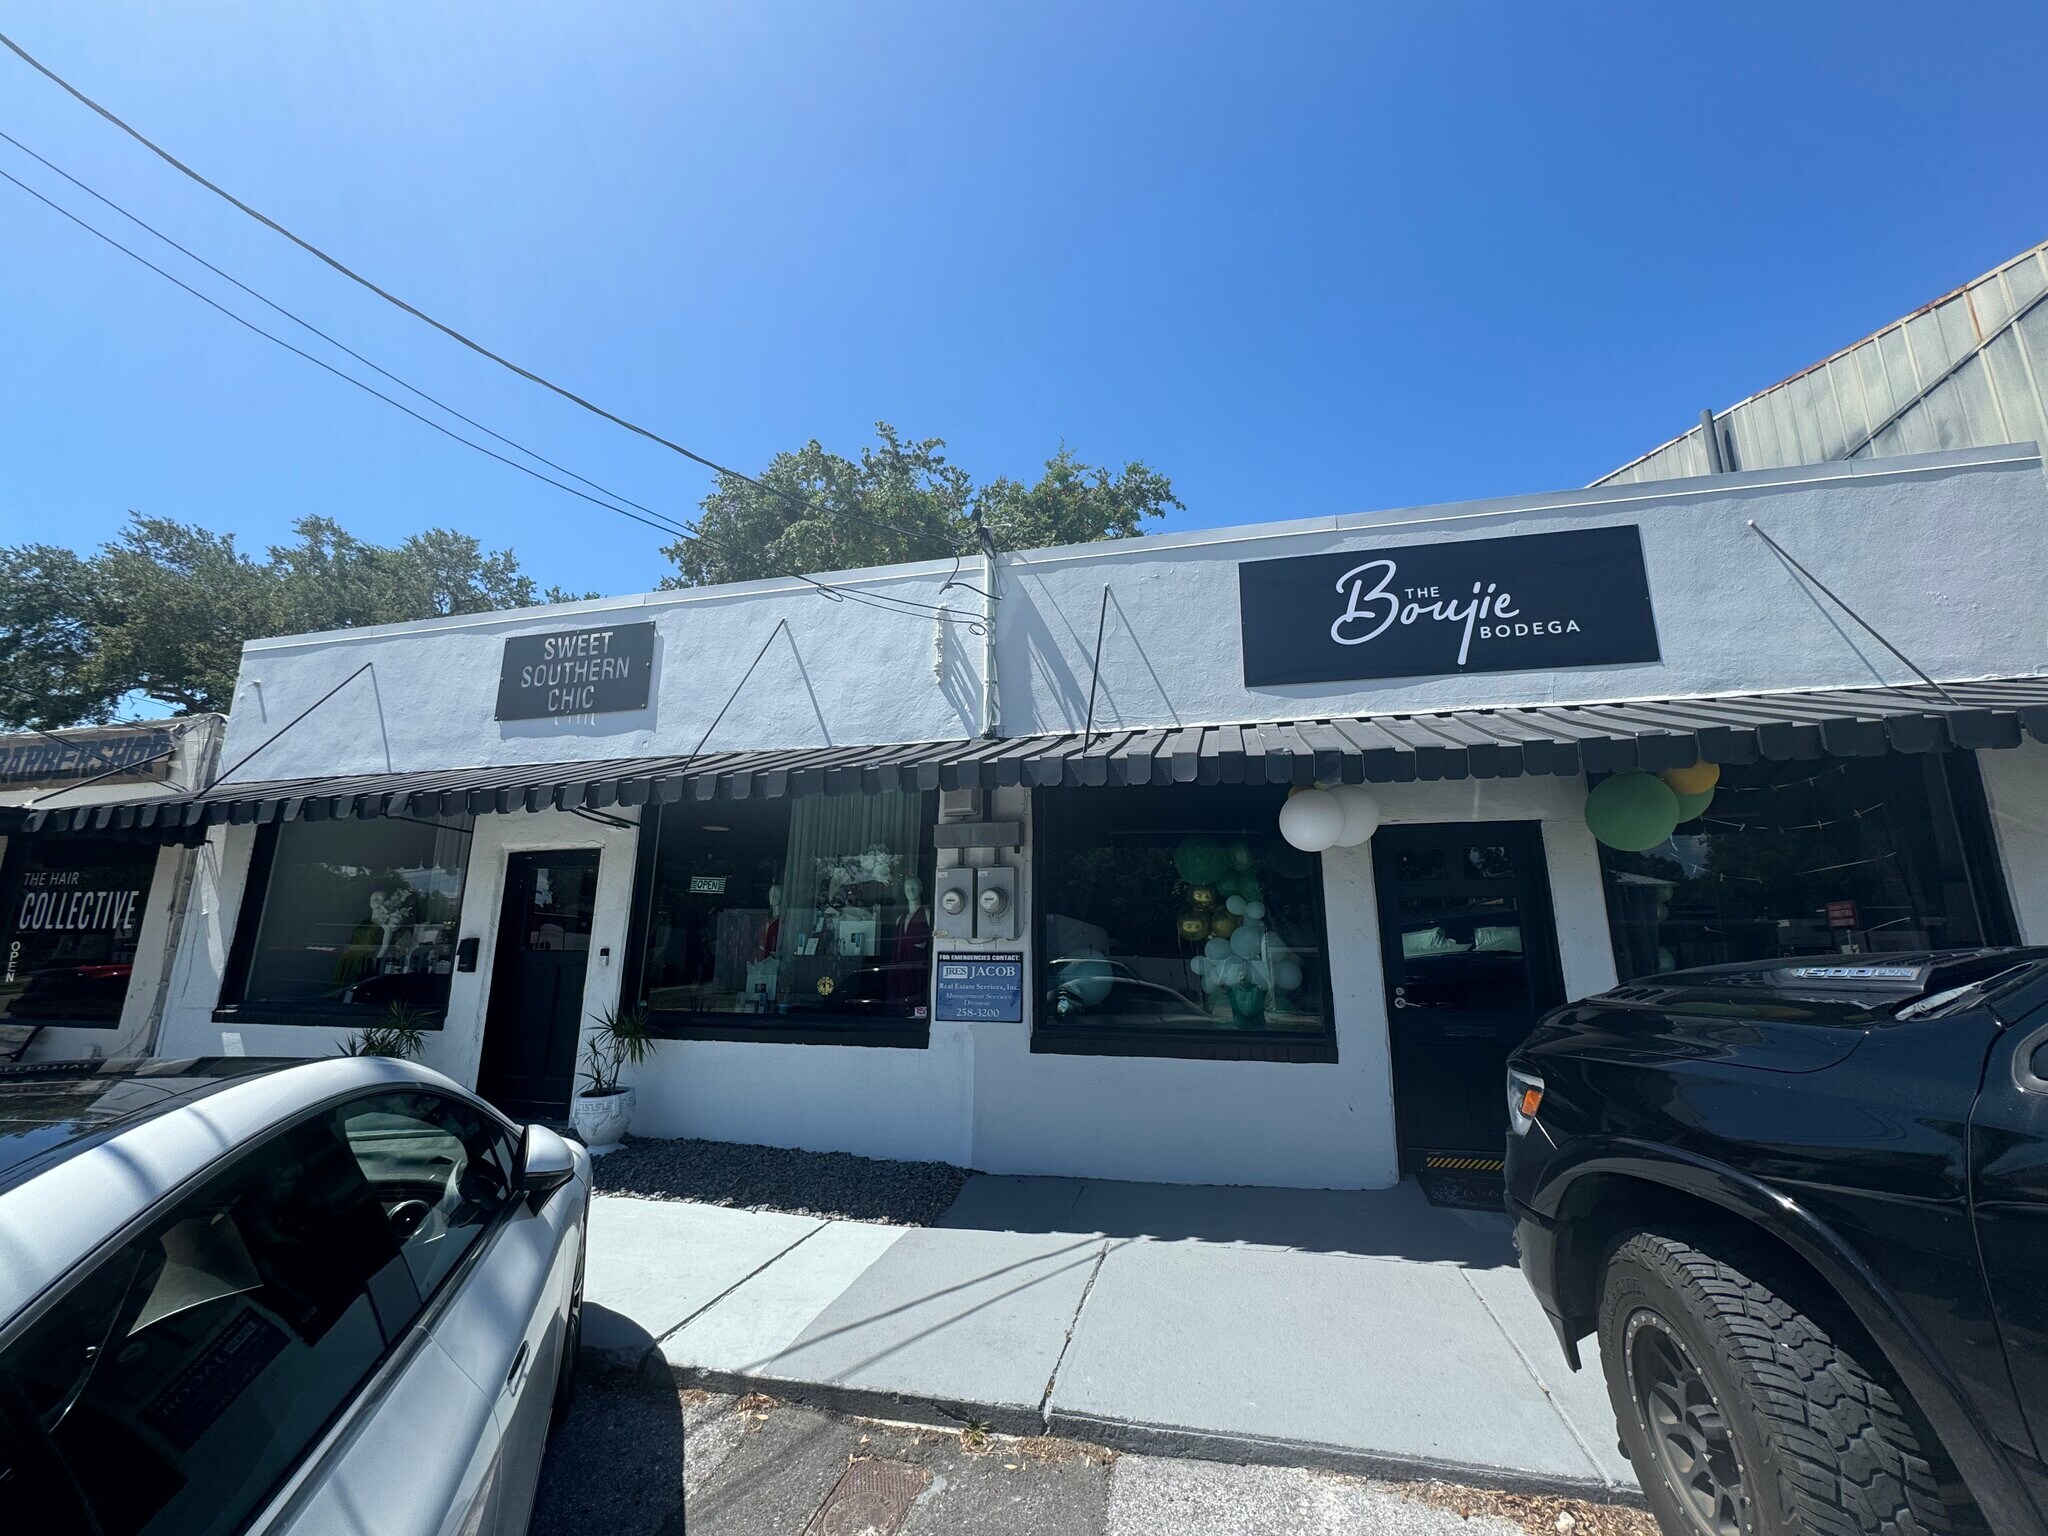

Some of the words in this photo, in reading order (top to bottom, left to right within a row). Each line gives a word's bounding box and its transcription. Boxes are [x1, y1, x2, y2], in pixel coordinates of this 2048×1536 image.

[1404, 586, 1440, 599] THE
[1330, 559, 1520, 665] Boujie
[1480, 620, 1581, 639] BODEGA
[543, 631, 614, 661] SWEET
[520, 656, 630, 688] SOUTHERN
[547, 685, 595, 712] CHIC
[23, 872, 48, 886] THE
[49, 872, 80, 885] HAIR
[697, 880, 718, 889] OPEN
[18, 890, 140, 930] COLLECTIVE
[5, 941, 21, 982] OPEN
[945, 967, 967, 976] JRES
[969, 966, 1016, 979] JACOB
[1795, 967, 1873, 978] 1500
[939, 982, 953, 990] Real
[976, 983, 1006, 991] Services,
[945, 992, 985, 1000] Management
[956, 1008, 1000, 1017] 258-3200
